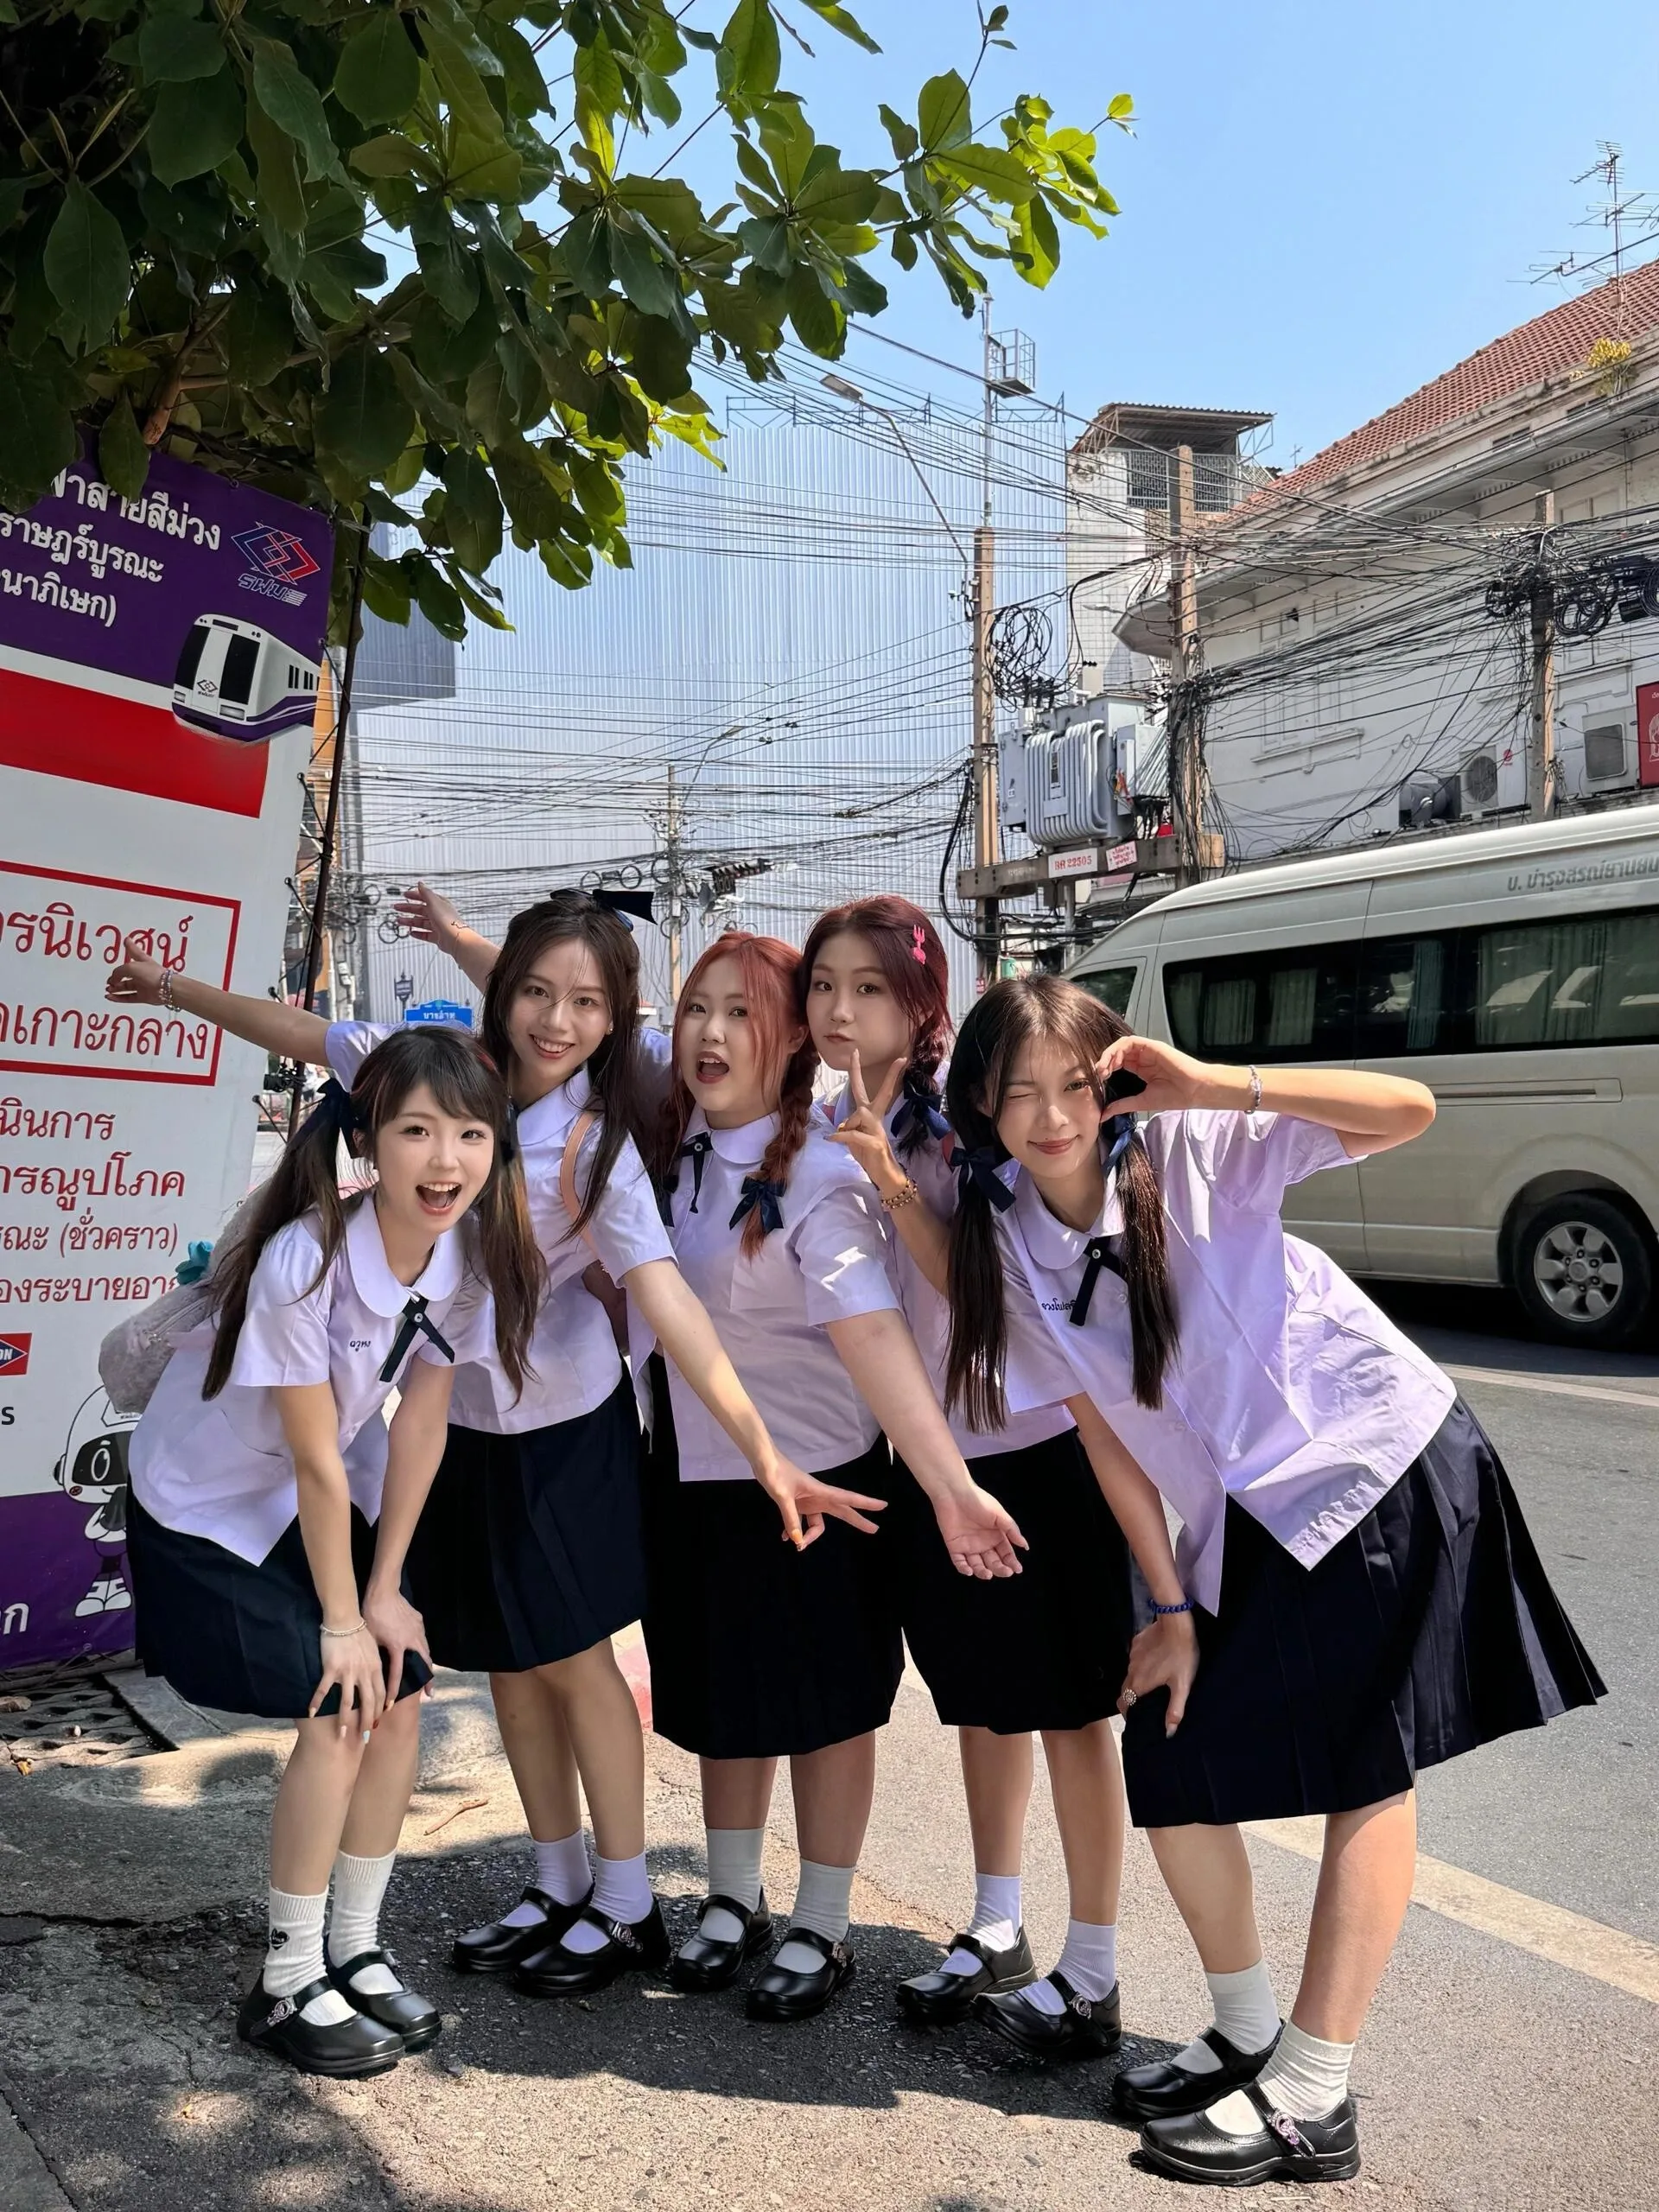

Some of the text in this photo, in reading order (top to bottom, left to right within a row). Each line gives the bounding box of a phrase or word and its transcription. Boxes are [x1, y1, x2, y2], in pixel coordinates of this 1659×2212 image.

[0, 902, 194, 973] รนิเวศน์
[0, 1206, 179, 1258] ณะ (ชั่วคราว)
